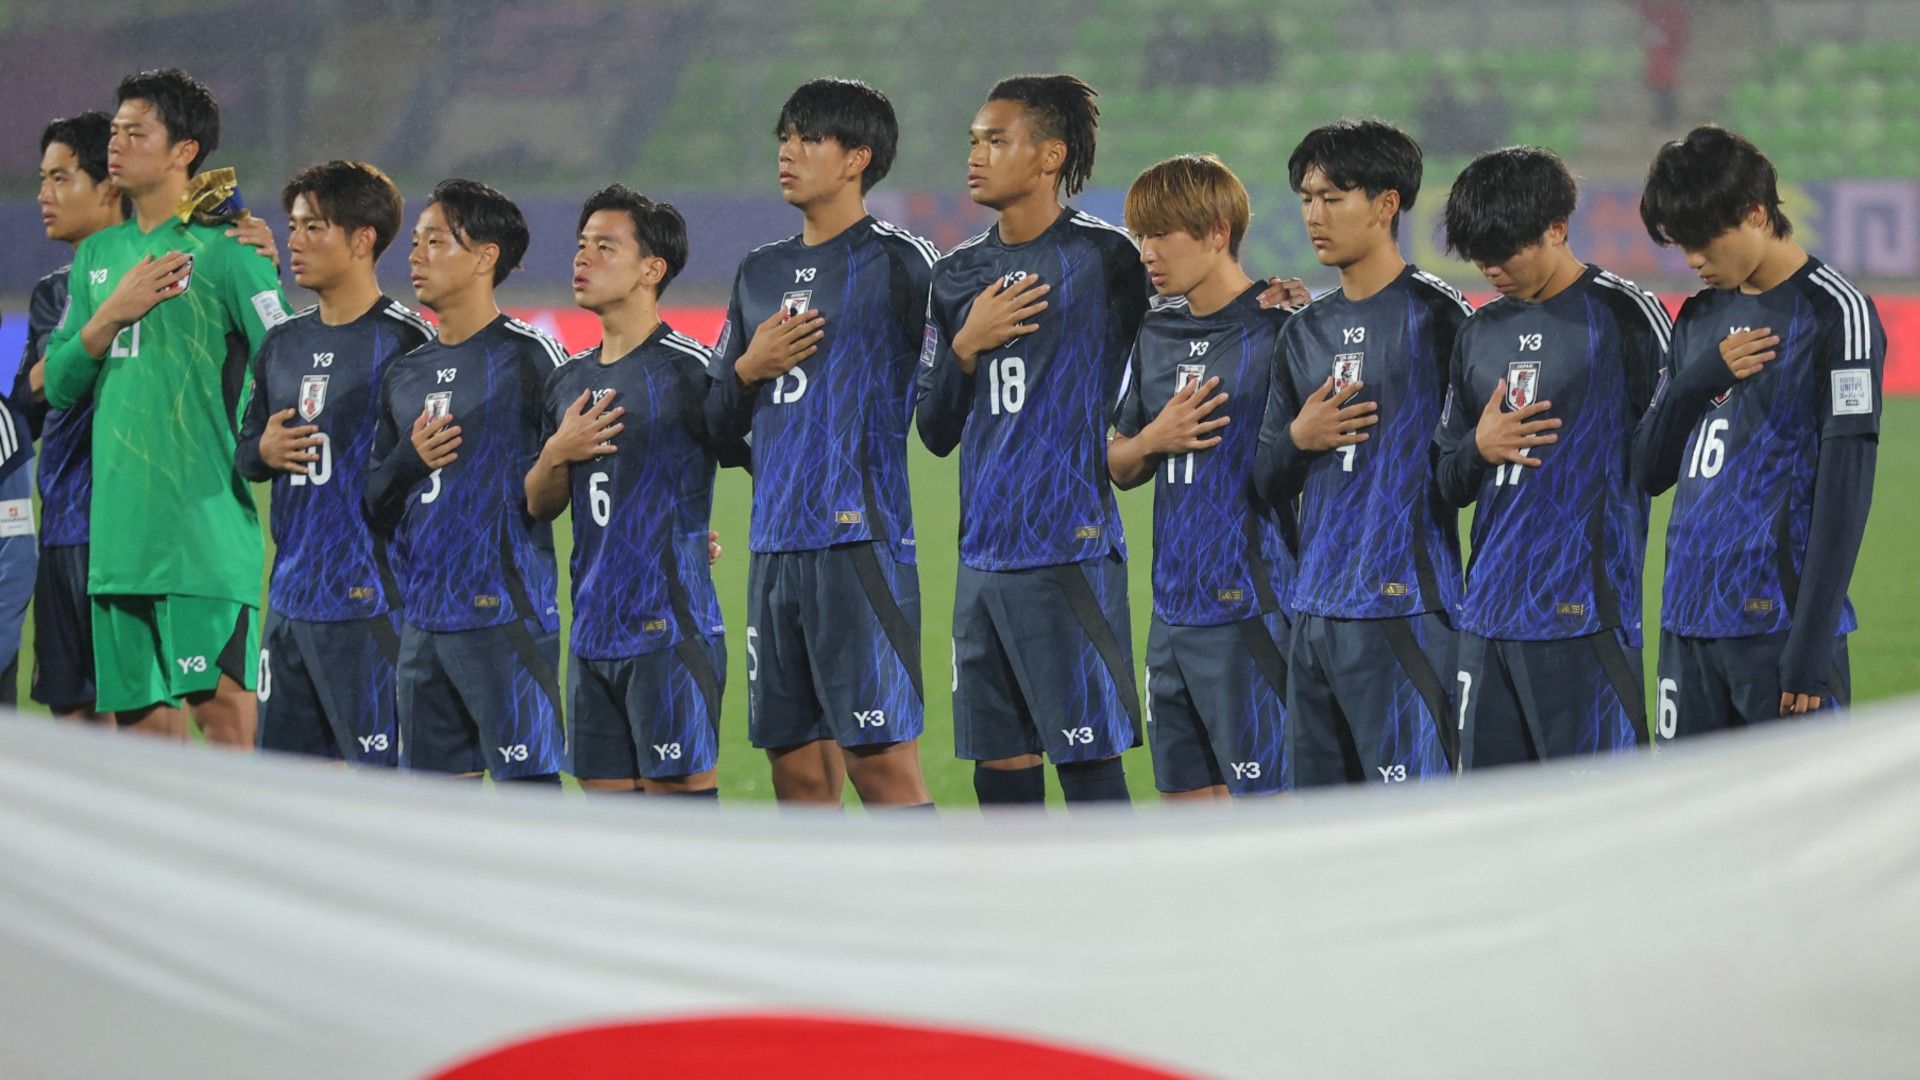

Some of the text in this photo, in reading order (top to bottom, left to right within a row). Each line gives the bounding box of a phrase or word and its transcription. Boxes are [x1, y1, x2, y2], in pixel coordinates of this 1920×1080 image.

[89, 268, 108, 285] Y-3
[795, 267, 816, 283] Y-3
[1343, 326, 1365, 345] Y-3
[1518, 333, 1542, 351] Y-3
[1189, 341, 1209, 357] Y-3
[313, 352, 334, 368] Y-3
[437, 367, 457, 384] Y-3
[989, 356, 1026, 415] 18
[592, 387, 616, 405] Y-
[1688, 418, 1729, 478] 16
[589, 472, 610, 527] 6
[177, 655, 207, 674] Y-3
[853, 709, 885, 728] Y-3
[358, 733, 389, 753] Y-3
[1061, 726, 1094, 746] Y-3
[498, 743, 529, 763] Y-3
[652, 742, 682, 761] Y-3
[1231, 761, 1261, 780] Y-3
[1377, 764, 1407, 784] Y-3
